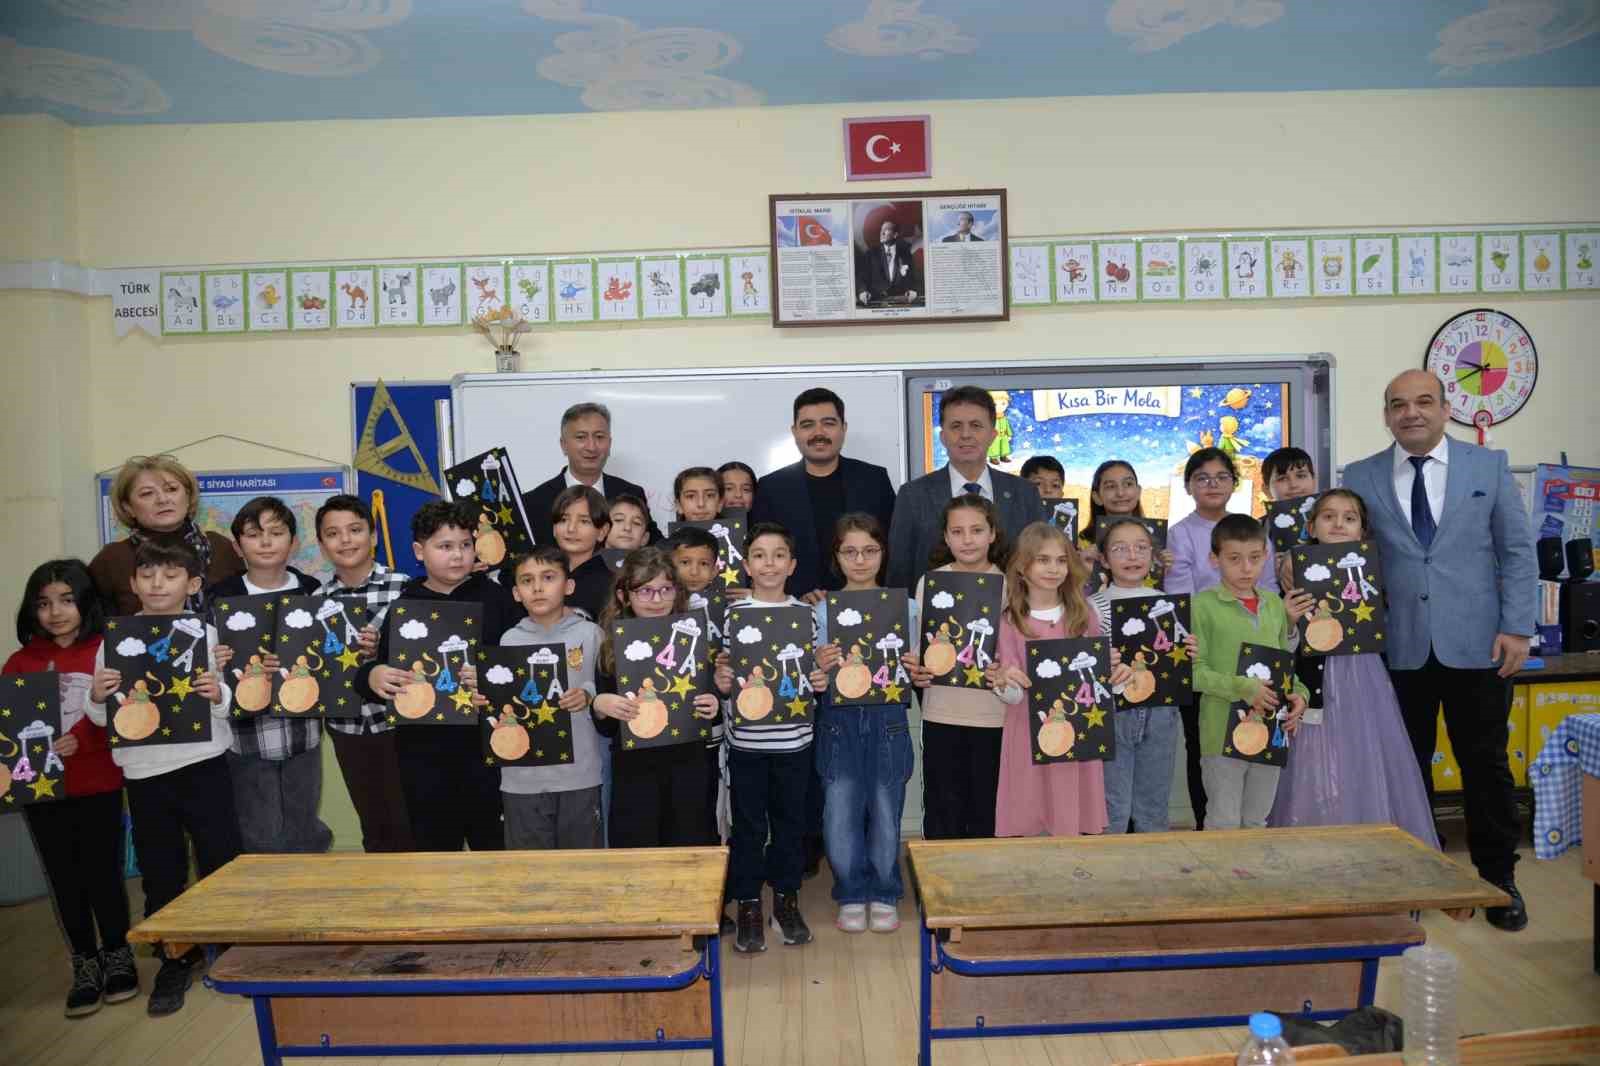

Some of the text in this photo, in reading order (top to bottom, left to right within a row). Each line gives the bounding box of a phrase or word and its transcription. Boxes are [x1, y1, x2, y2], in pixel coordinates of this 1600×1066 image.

[120, 282, 151, 295] TÜRK
[114, 306, 159, 318] ABECESİ
[1475, 325, 1488, 337] 12
[1458, 331, 1469, 344] 11
[1445, 345, 1456, 357] 10
[1442, 364, 1450, 375] 9
[1448, 382, 1455, 393] 8
[1058, 389, 1161, 410] Kısa Bir Mola
[1461, 395, 1468, 406] 7
